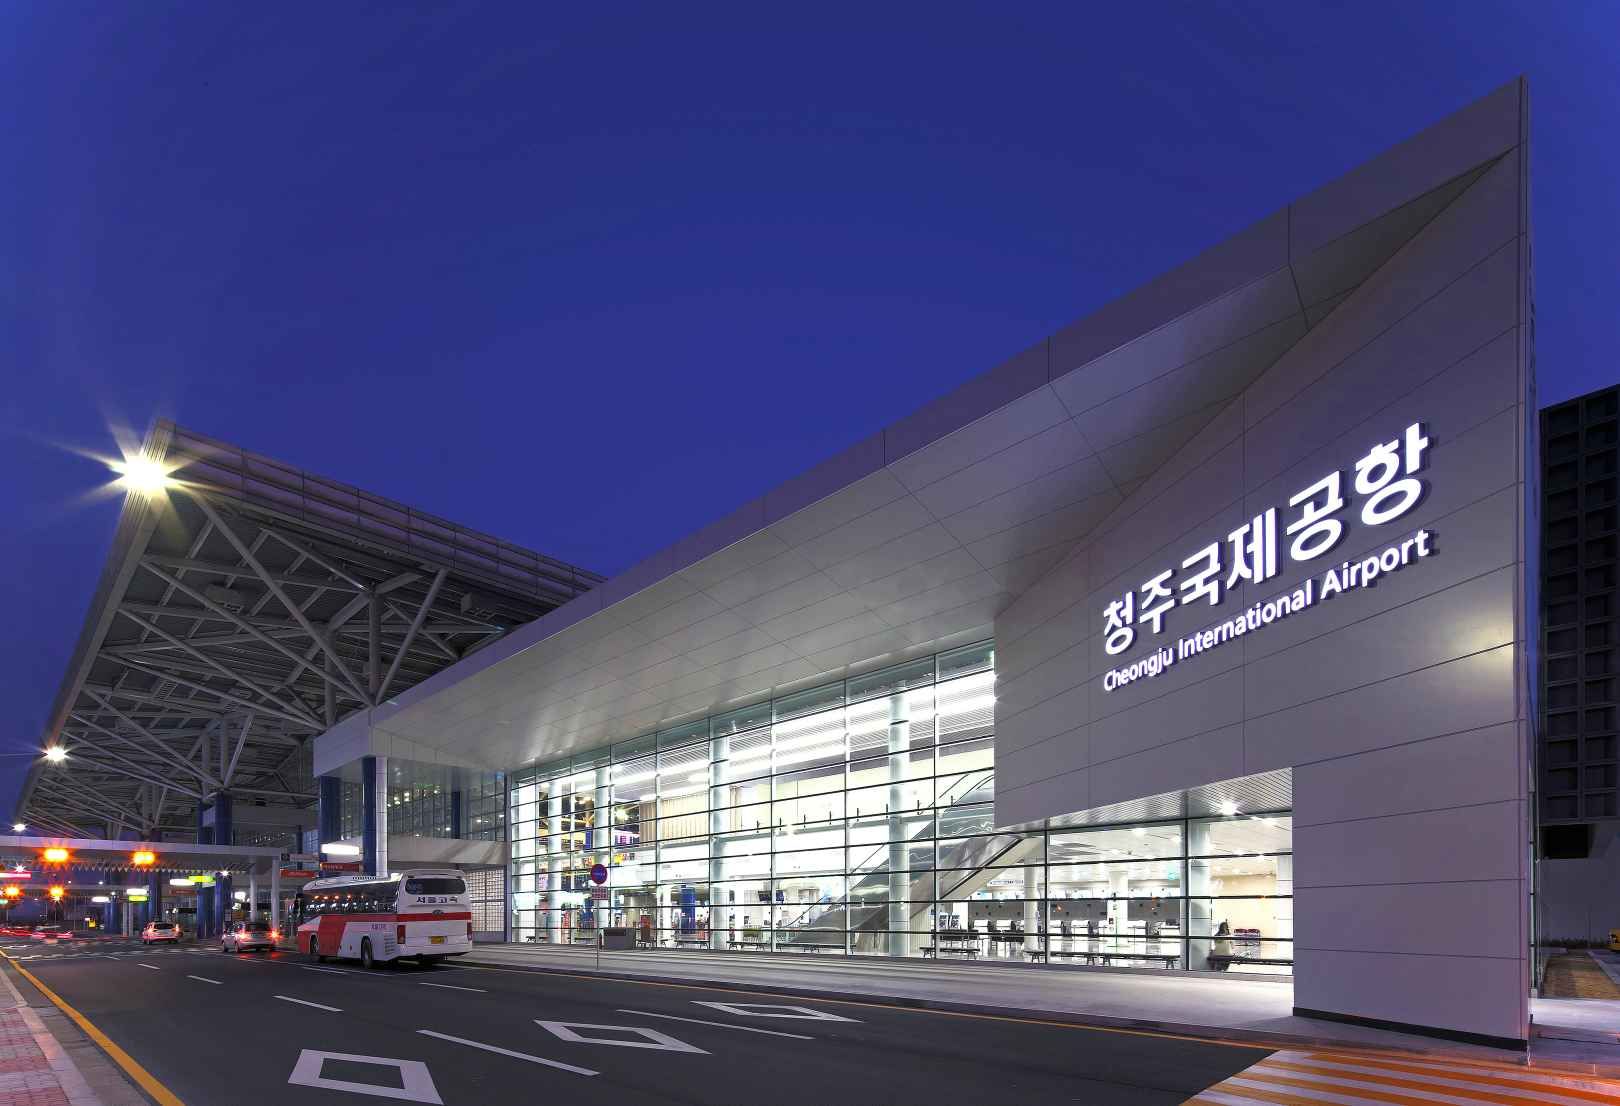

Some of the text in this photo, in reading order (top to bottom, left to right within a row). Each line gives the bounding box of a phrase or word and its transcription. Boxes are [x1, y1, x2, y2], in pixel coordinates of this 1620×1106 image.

[1103, 422, 1429, 656] 청주국제공항
[1103, 529, 1430, 692] Cheongju International Airport
